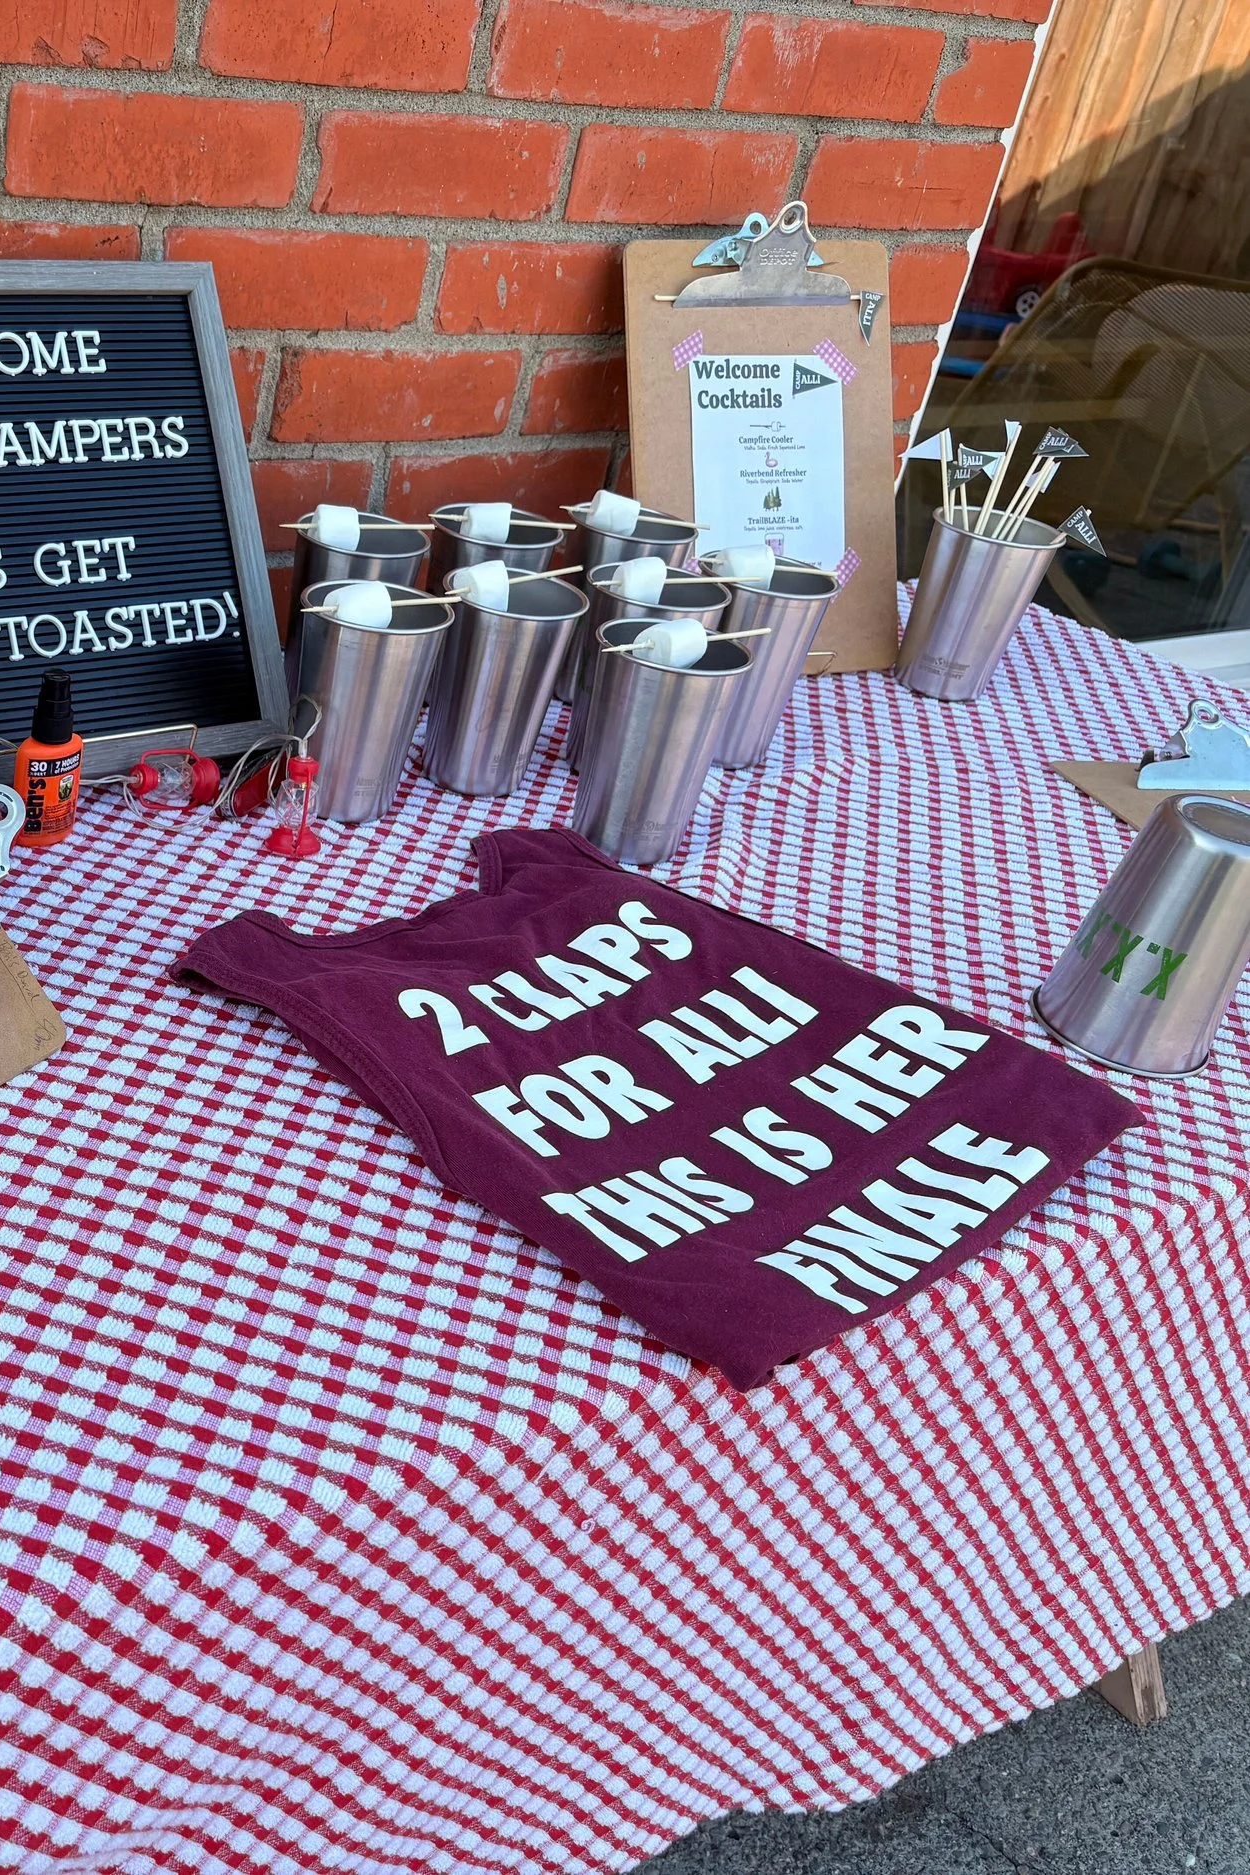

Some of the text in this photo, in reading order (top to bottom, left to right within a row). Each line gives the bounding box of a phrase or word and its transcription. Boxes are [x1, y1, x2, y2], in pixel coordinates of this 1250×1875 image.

[863, 292, 881, 326] CAMP ALLI
[692, 358, 781, 380] Welcome
[801, 374, 821, 385] ALLI
[697, 387, 783, 410] Cocktails
[738, 434, 794, 445] Campfire Cooler
[1048, 436, 1069, 447] ALLI
[967, 455, 983, 466] ALLI
[739, 468, 807, 478] Riverbend Refresher
[954, 469, 971, 479] ALLI
[1067, 510, 1096, 545] CAMP ALLI
[34, 536, 136, 589] GET
[30, 761, 47, 772] 30
[55, 753, 80, 769] 7 HOURS
[23, 778, 47, 833] Ben's
[398, 900, 693, 1056] 2 CLAPS
[472, 966, 819, 1158] FOR ALLI
[541, 1004, 991, 1263] THIS IS HER
[754, 1121, 1050, 1315] FINALE
